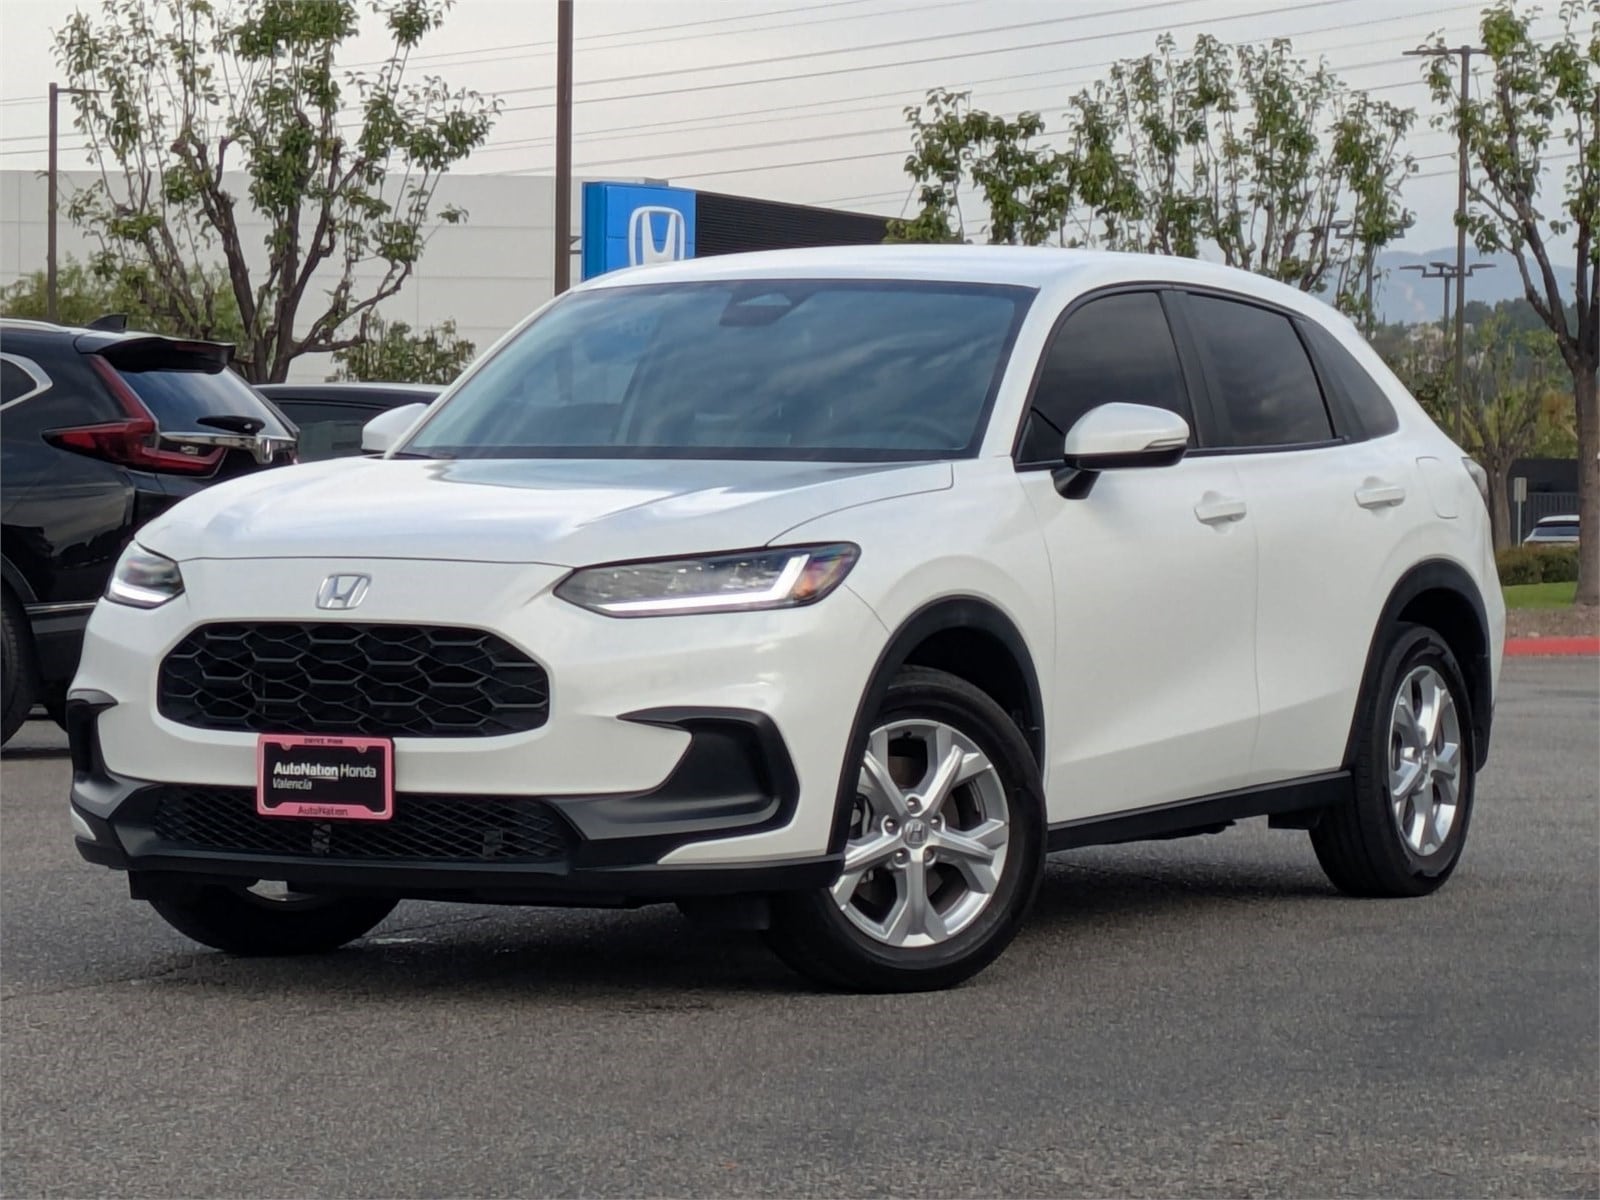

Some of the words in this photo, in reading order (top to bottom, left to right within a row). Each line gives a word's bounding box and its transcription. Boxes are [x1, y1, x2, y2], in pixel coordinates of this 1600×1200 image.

[273, 761, 339, 777] AutoNation
[340, 763, 377, 778] Honda
[272, 777, 313, 790] Valencia
[297, 806, 348, 816] AutoNation
